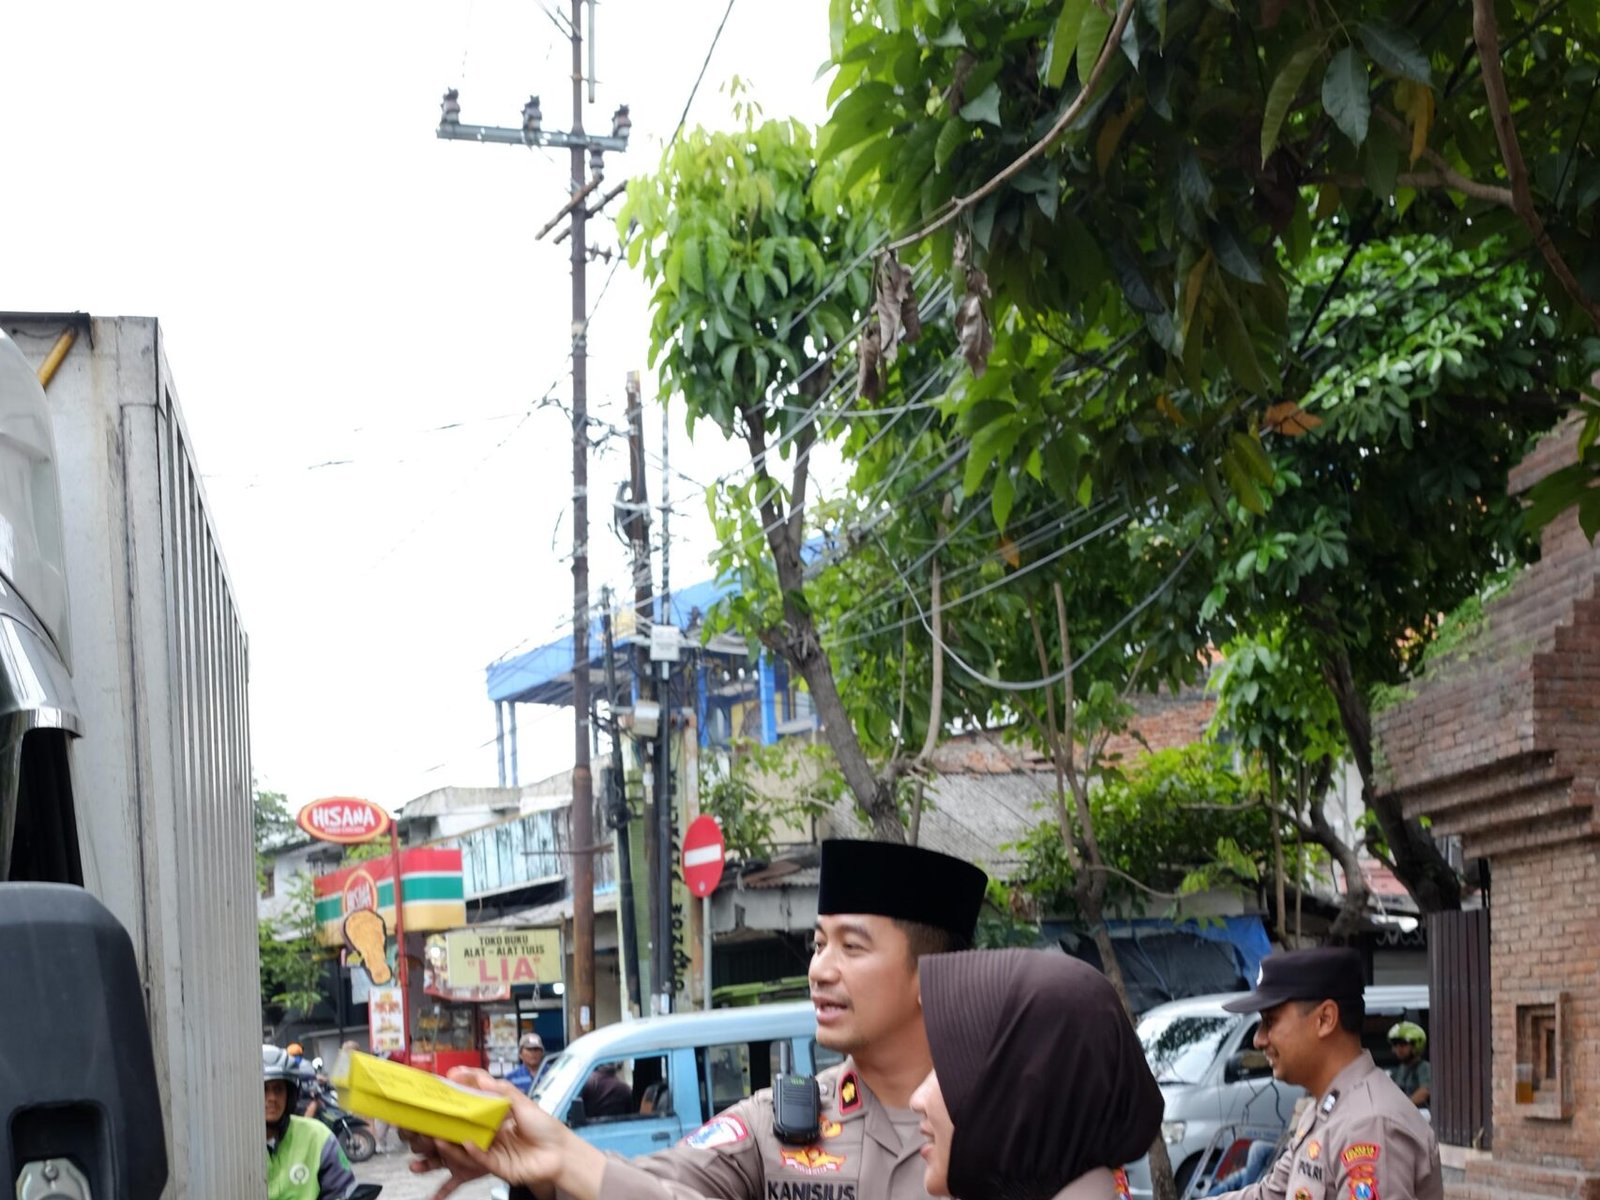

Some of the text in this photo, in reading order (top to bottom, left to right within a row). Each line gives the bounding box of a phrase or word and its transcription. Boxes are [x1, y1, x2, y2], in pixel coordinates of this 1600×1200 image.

[311, 806, 375, 828] HISANA
[479, 934, 528, 946] TOKO BUKU
[463, 947, 485, 958] ALAT
[496, 945, 518, 957] ALAT
[521, 944, 545, 955] TULIS
[1298, 1161, 1322, 1181] POLRI
